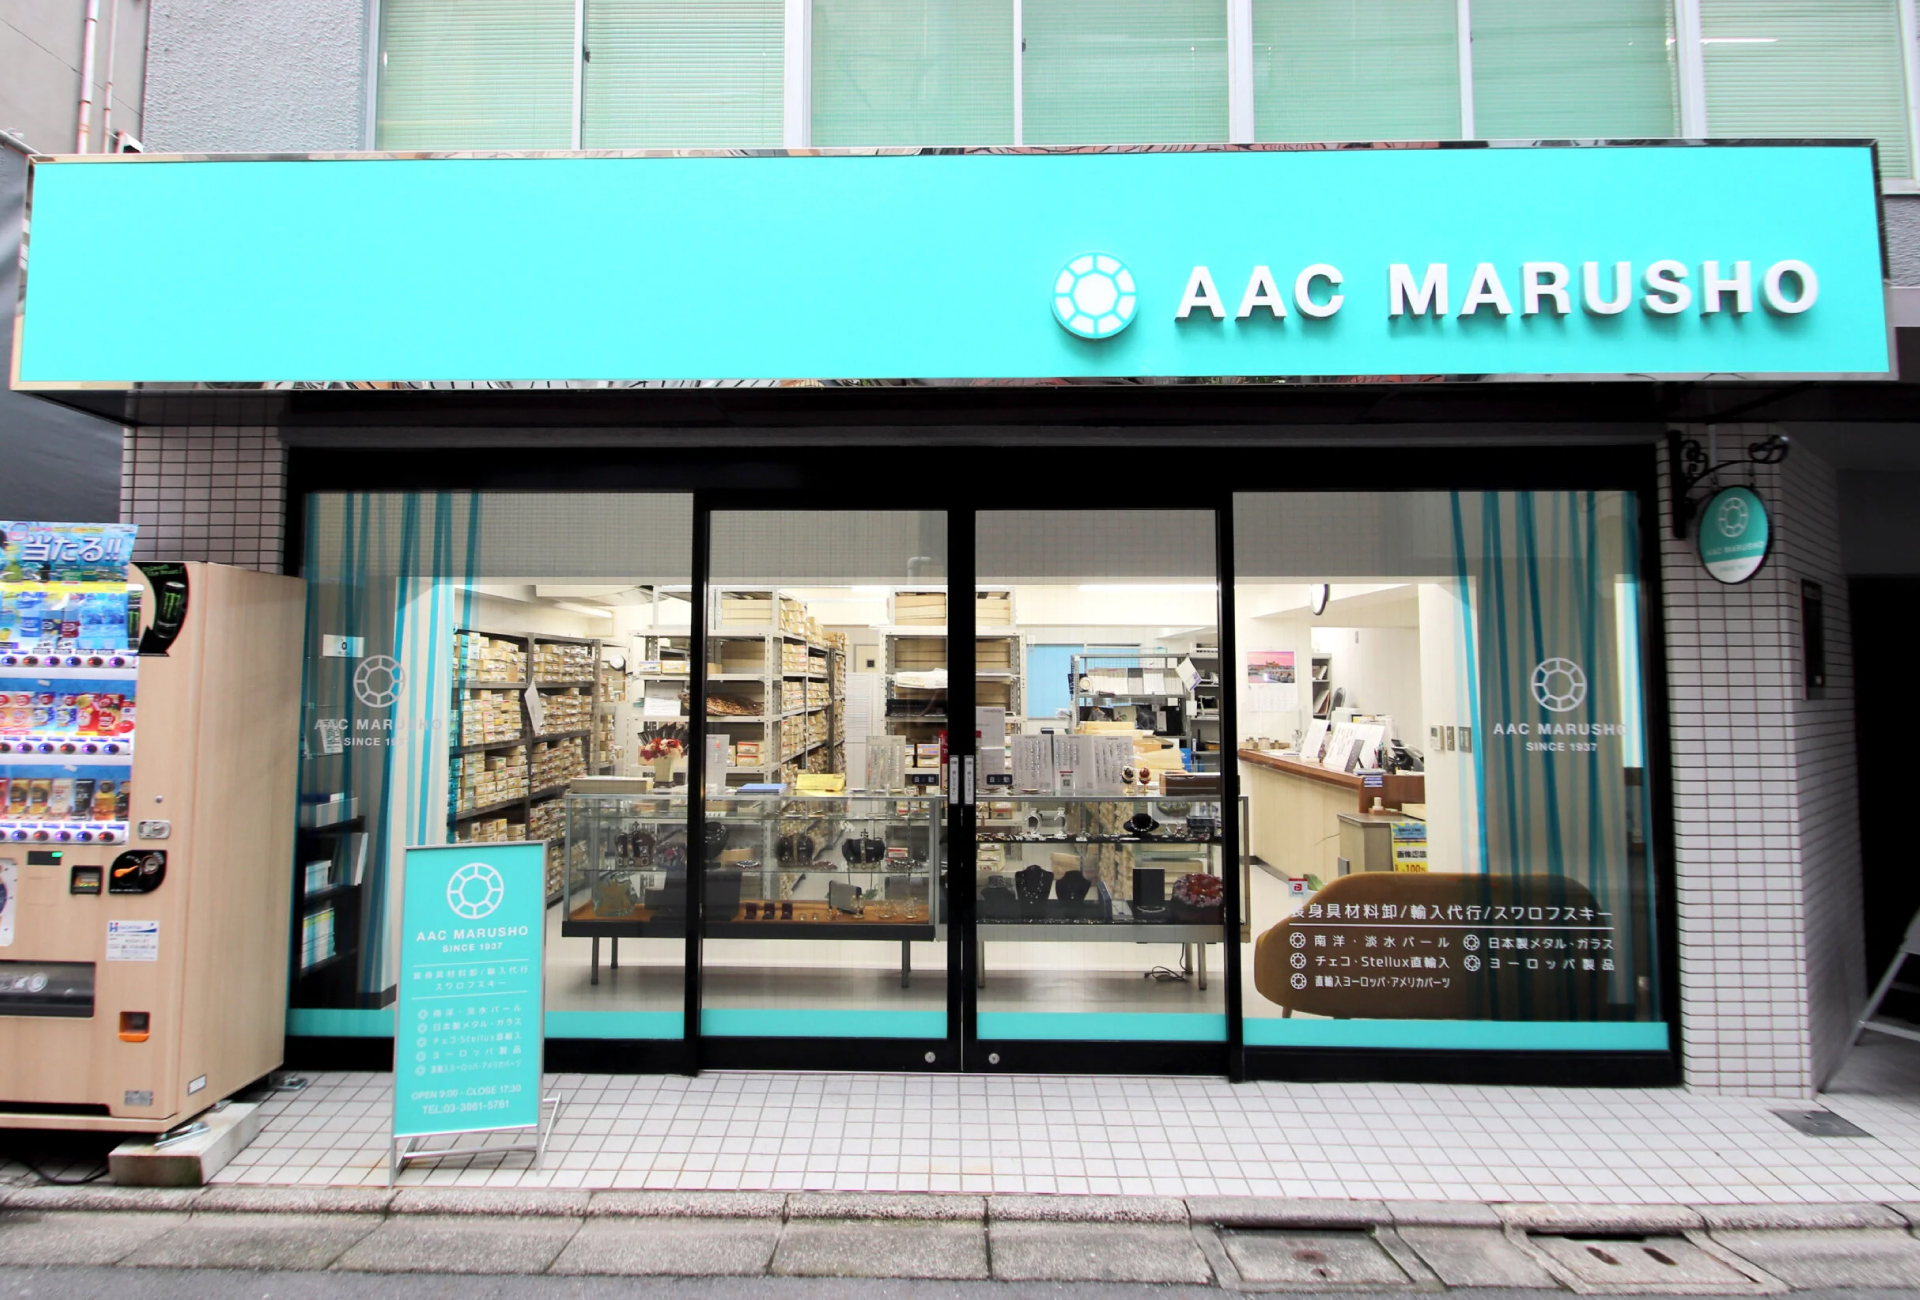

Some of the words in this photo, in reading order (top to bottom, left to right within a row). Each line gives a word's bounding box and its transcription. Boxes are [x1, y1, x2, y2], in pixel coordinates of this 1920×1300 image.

[1175, 263, 1345, 321] AAC
[1387, 259, 1819, 321] MARUSHO
[314, 719, 348, 730] AAC
[1493, 723, 1530, 735] AAC
[1538, 723, 1627, 735] MARUSHO
[344, 738, 381, 746] SINCE
[1526, 742, 1565, 751] SINCE
[1570, 742, 1598, 751] 1937
[416, 930, 447, 942] AAC
[453, 926, 529, 940] MARUSHO
[442, 943, 475, 953] SINCE
[479, 942, 503, 951] 1937
[411, 1091, 437, 1101] OPEN
[466, 1086, 497, 1096] CLOSE
